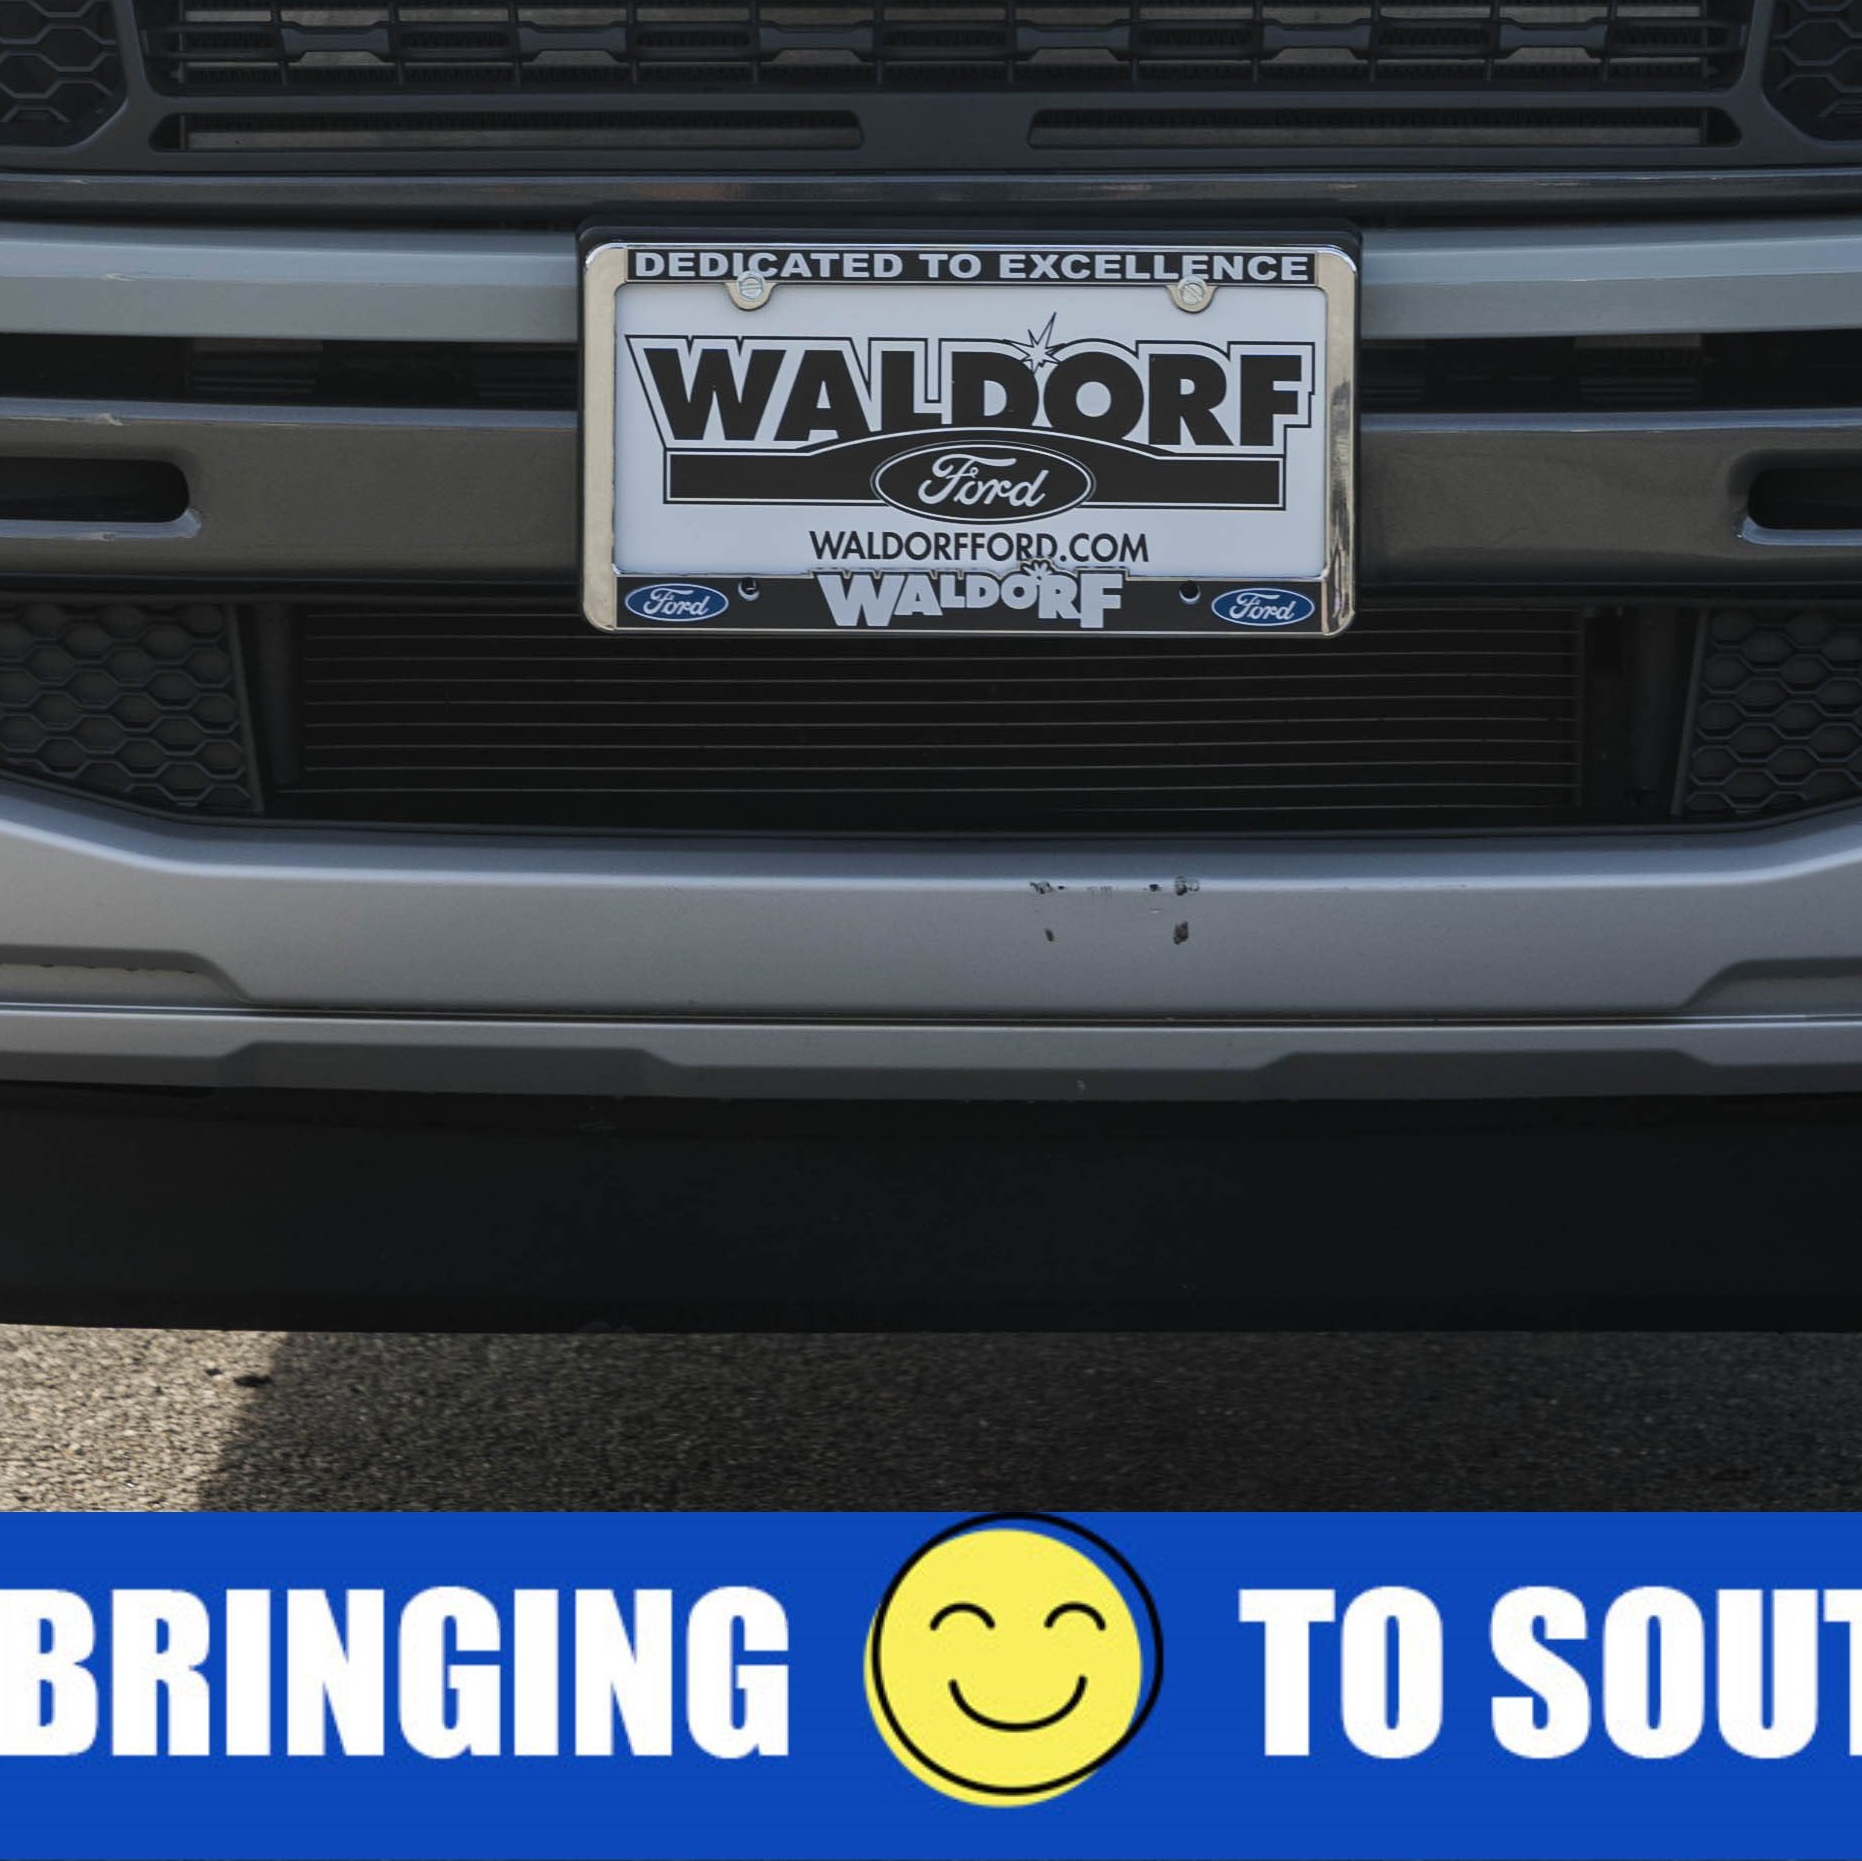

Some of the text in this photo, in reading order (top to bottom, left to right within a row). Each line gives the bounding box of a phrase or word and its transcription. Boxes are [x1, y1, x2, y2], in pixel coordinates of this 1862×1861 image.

[636, 252, 1309, 280] DEDICATED TO EXCELLENCE
[625, 335, 1314, 448] WALDORF
[917, 453, 1045, 509] Ford
[810, 531, 1149, 563] WALDORFFORD.COM
[643, 587, 710, 615] Ford
[815, 572, 1123, 628] WALDORF
[1229, 591, 1294, 621] Ford
